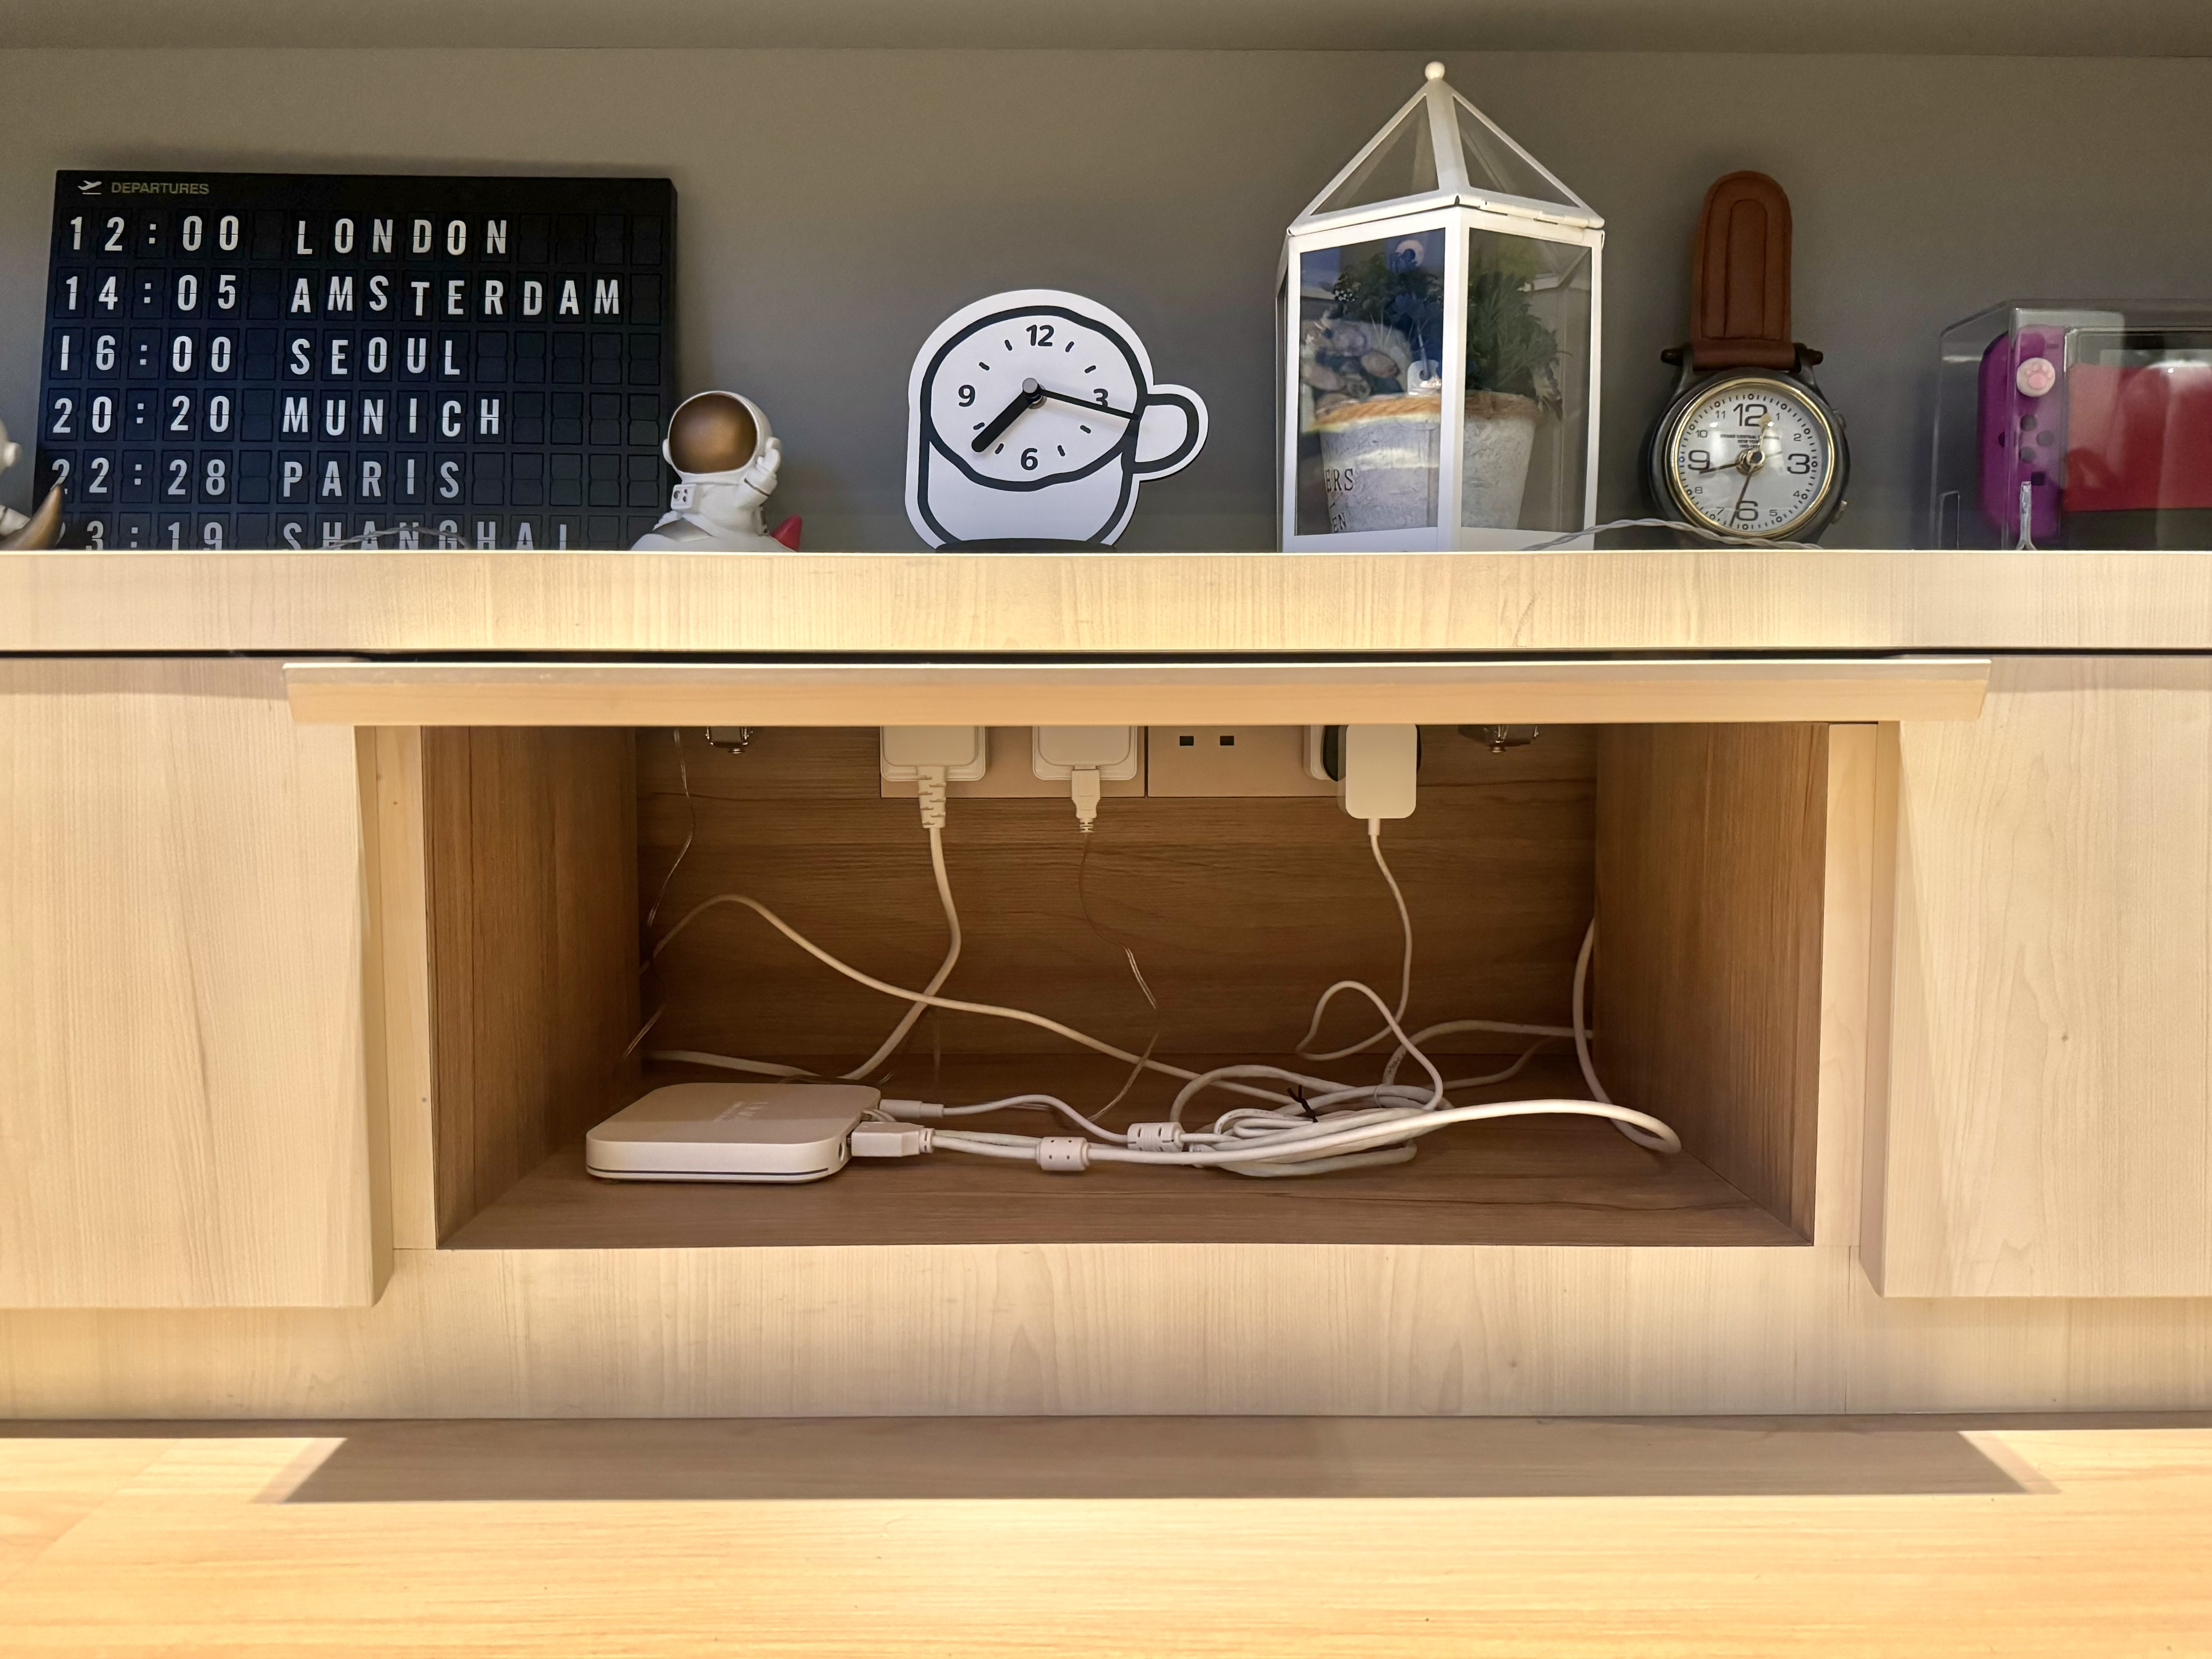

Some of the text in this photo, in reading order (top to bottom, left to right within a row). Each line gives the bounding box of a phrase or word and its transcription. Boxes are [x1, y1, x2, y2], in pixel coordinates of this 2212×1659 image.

[111, 182, 209, 195] DEPARTURES
[70, 215, 507, 255] 12:00 LONDON
[66, 275, 619, 316] 14:05 AMSTERDAM
[1026, 325, 1054, 347] 12
[290, 337, 460, 375] SEOUL
[958, 385, 975, 407] 9
[1093, 388, 1109, 407] 3
[52, 395, 499, 437] 20:20 MUNICH
[1715, 410, 1726, 419] 11
[1733, 403, 1768, 427] 12
[1695, 430, 1707, 438] 10
[1021, 447, 1038, 471] 6
[1687, 450, 1710, 471] 9
[1787, 453, 1810, 475] 3
[283, 459, 459, 498] PARIS
[1735, 501, 1759, 521] 6
[54, 520, 222, 550] 3:19
